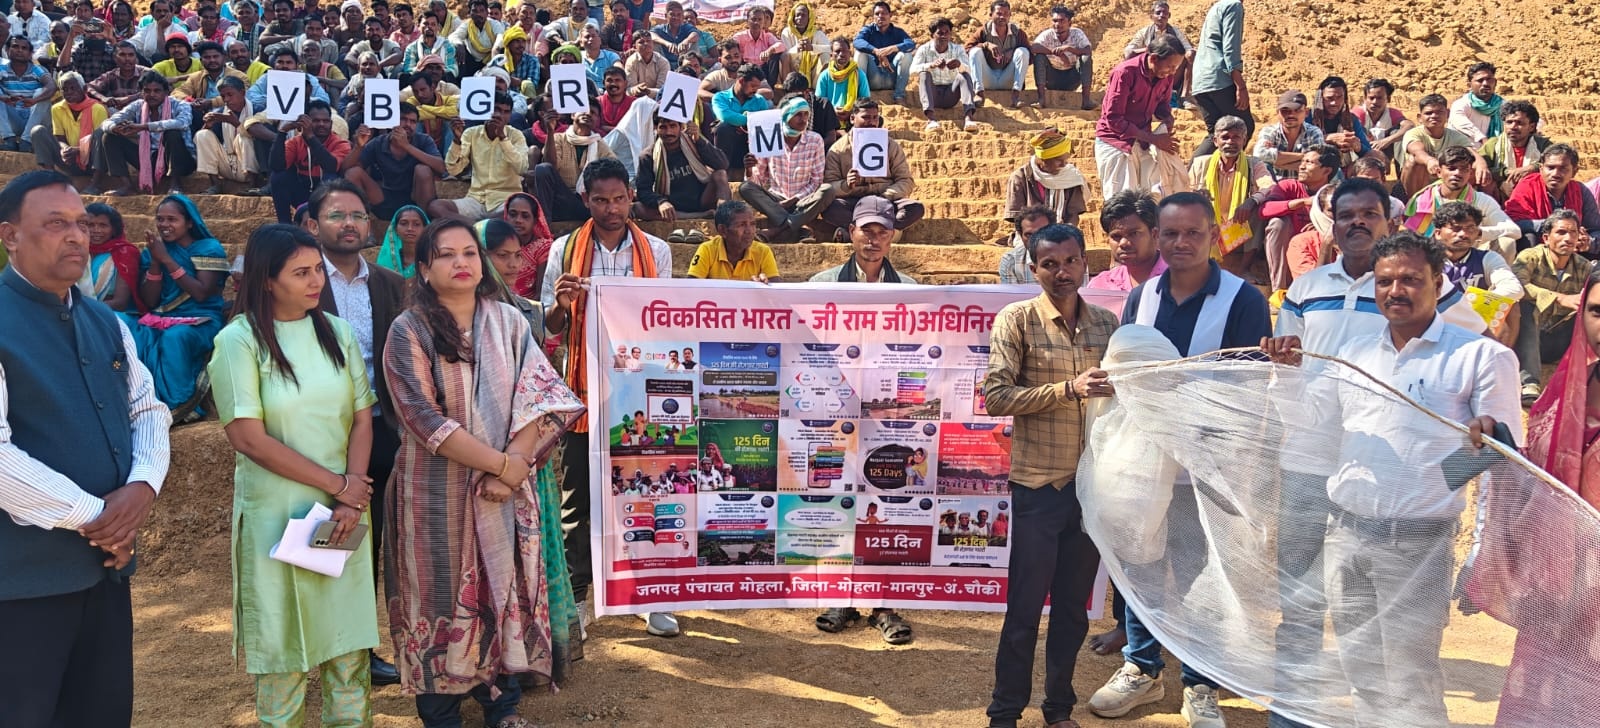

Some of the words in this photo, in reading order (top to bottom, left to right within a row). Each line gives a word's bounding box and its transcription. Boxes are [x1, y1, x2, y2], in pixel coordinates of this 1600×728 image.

[272, 85, 300, 115] V
[370, 93, 393, 121] B
[466, 89, 492, 116] G
[557, 79, 585, 109] R
[662, 88, 688, 118] A
[755, 123, 784, 153] M
[858, 142, 884, 171] G
[692, 254, 700, 266] 3
[641, 300, 737, 331] (विकसित
[741, 309, 793, 330] भारत
[812, 302, 838, 331] जी
[842, 310, 878, 331] राम
[734, 436, 750, 446] 125
[752, 434, 770, 446] दिन
[870, 468, 882, 476] 125
[884, 468, 902, 477] Days
[865, 537, 890, 548] 125
[893, 534, 922, 548] दिन
[636, 583, 680, 596] जनपद
[686, 578, 735, 594] पंचायत
